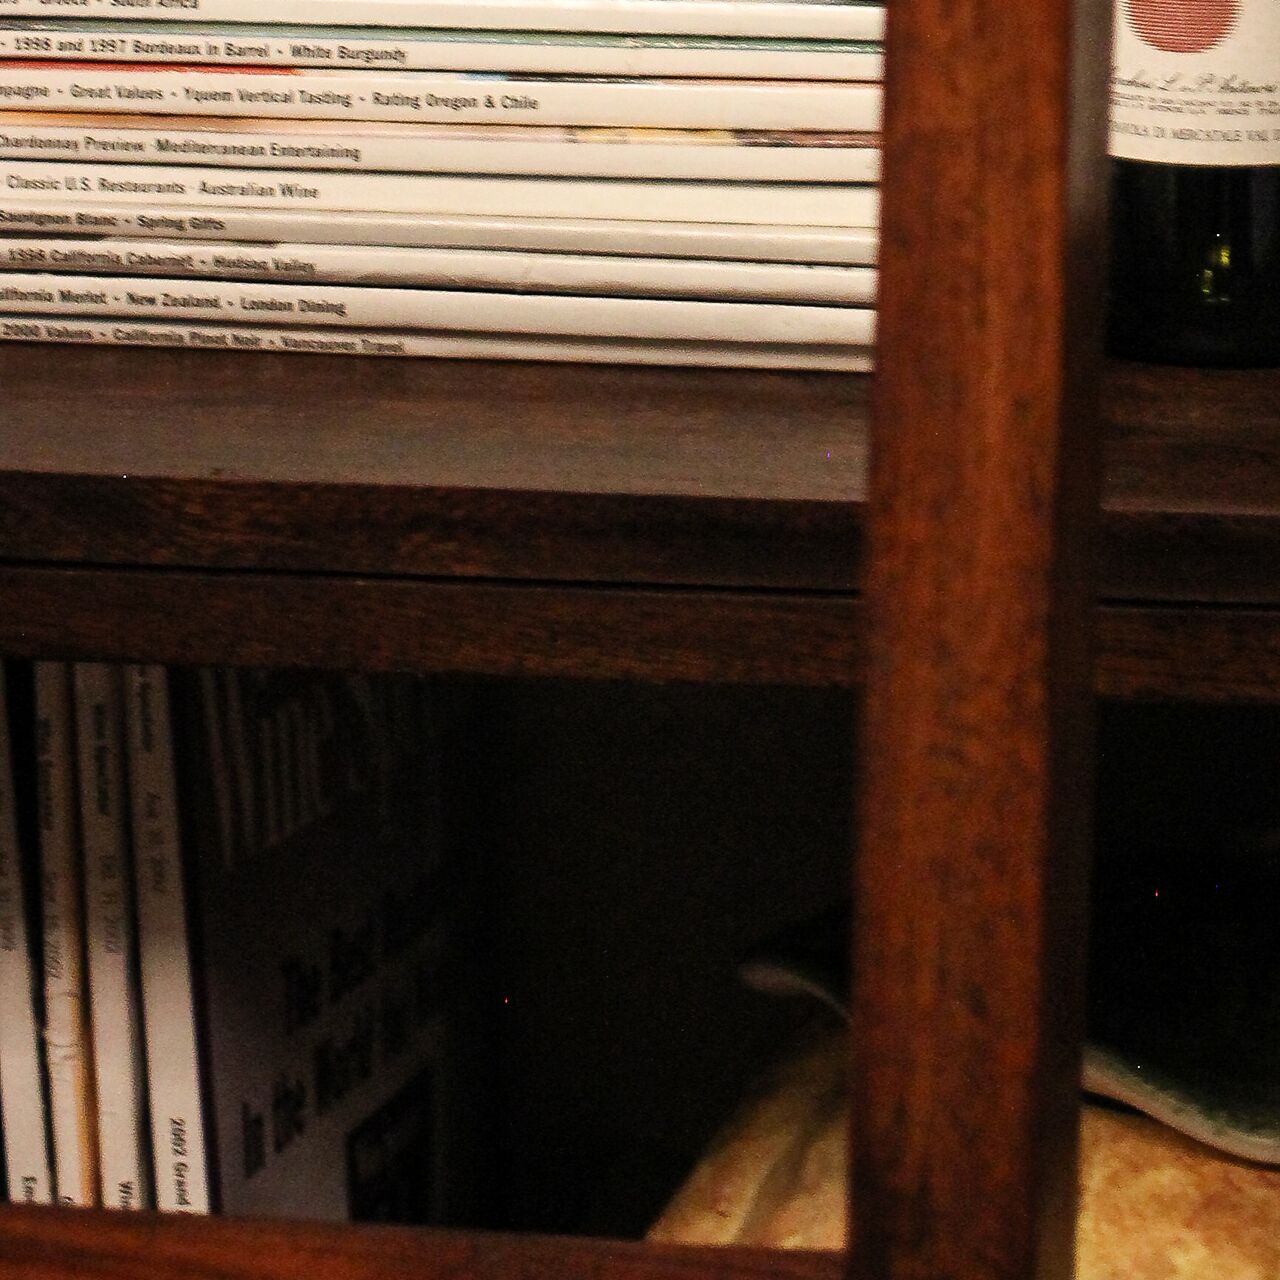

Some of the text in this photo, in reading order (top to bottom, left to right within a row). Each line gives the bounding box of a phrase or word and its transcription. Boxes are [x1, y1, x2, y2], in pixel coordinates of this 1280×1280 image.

[57, 38, 84, 52] and
[132, 39, 202, 55] Bordeaux
[225, 41, 270, 57] Barrel
[288, 43, 333, 59] White
[337, 44, 408, 64] Burgundy
[70, 83, 112, 99] Great
[114, 84, 165, 100] Values
[182, 85, 234, 103] Yquem
[237, 87, 295, 104] Vertical
[299, 89, 353, 109] Tasting
[371, 91, 421, 110] Rating
[425, 92, 479, 111] Oregon
[483, 94, 497, 109] &
[501, 95, 541, 111] Chile
[83, 136, 146, 153] Preview
[155, 138, 267, 156] Mediterranean
[269, 142, 362, 162] Entertaining
[6, 174, 60, 191] Classic
[97, 177, 186, 195] Restaurants
[200, 180, 276, 197] Australian
[279, 182, 321, 199] Wine
[136, 214, 187, 232] Spring
[188, 216, 227, 231] Gifts
[49, 248, 123, 265] California
[0, 286, 54, 303] lifornia
[58, 288, 107, 304] Merlot
[126, 291, 157, 306] New
[240, 295, 295, 311] London
